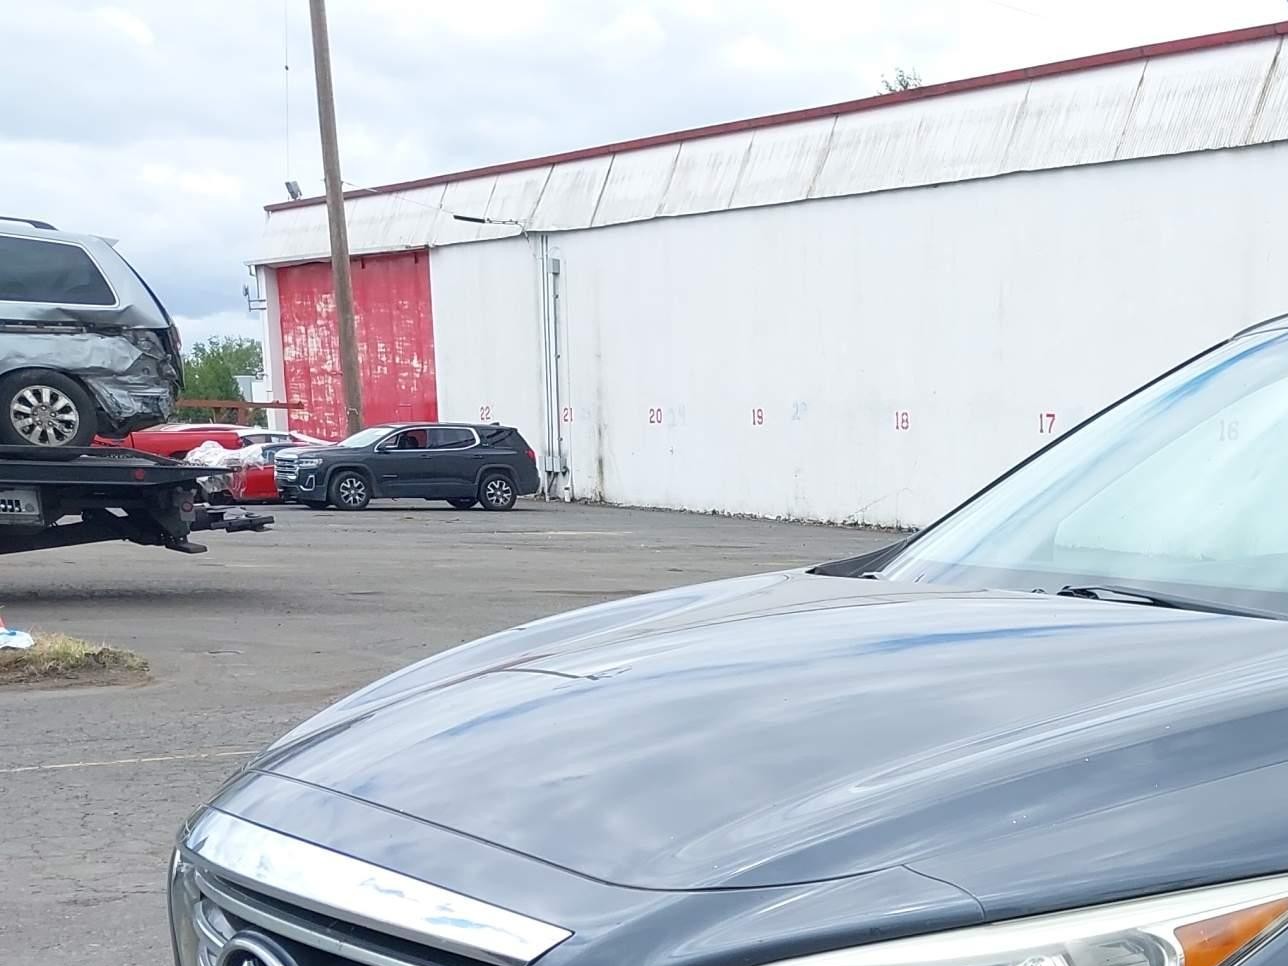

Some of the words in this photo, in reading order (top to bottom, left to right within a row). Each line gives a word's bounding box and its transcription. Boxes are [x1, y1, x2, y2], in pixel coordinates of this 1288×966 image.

[480, 406, 491, 421] 22
[563, 407, 573, 422] 21
[649, 408, 663, 424] 20
[752, 408, 764, 426] 19
[895, 411, 910, 430] 18
[1039, 413, 1056, 434] 17
[1217, 419, 1239, 442] 16
